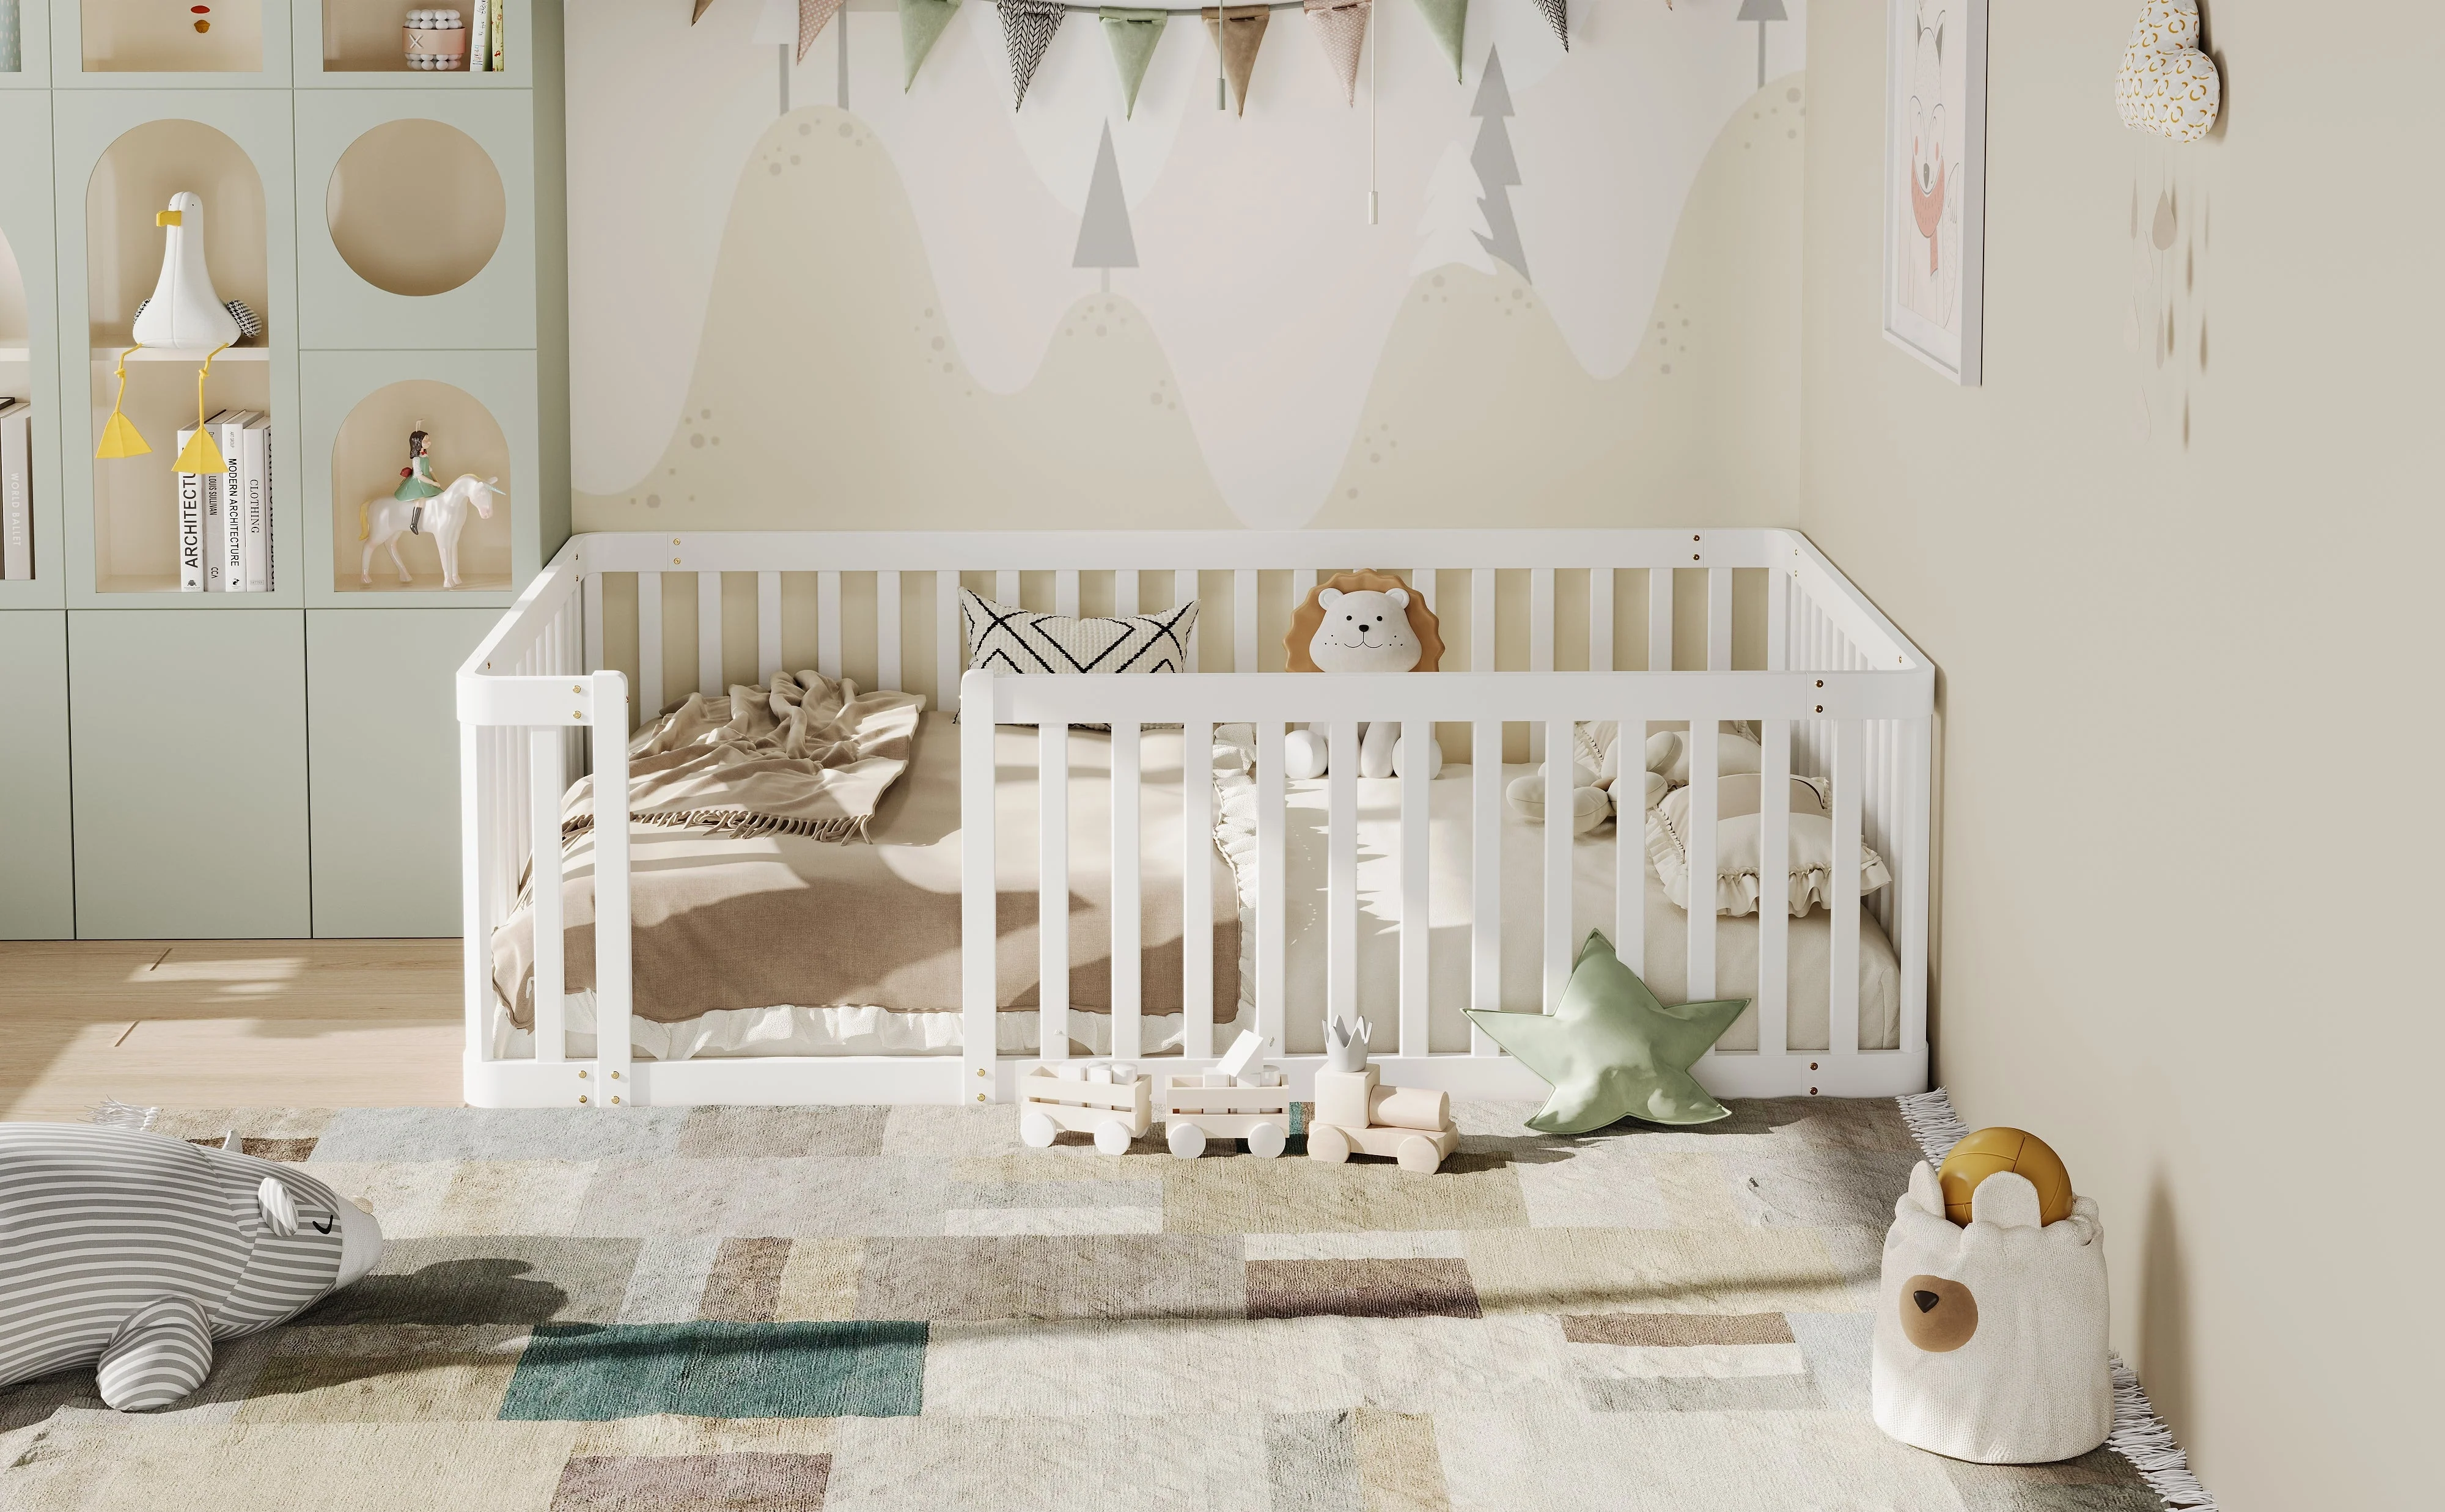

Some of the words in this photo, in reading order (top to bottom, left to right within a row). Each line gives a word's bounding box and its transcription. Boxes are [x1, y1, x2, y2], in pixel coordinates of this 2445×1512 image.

[11, 473, 20, 508] WORLD
[208, 475, 217, 491] LOUIS
[228, 458, 238, 496] MODERN
[182, 448, 198, 568] ARCHITECTU
[208, 491, 218, 515] SULLIVAN
[250, 479, 260, 534] CLOTHING
[12, 513, 21, 546] BALLET
[229, 499, 239, 567] ARCHITECTURE
